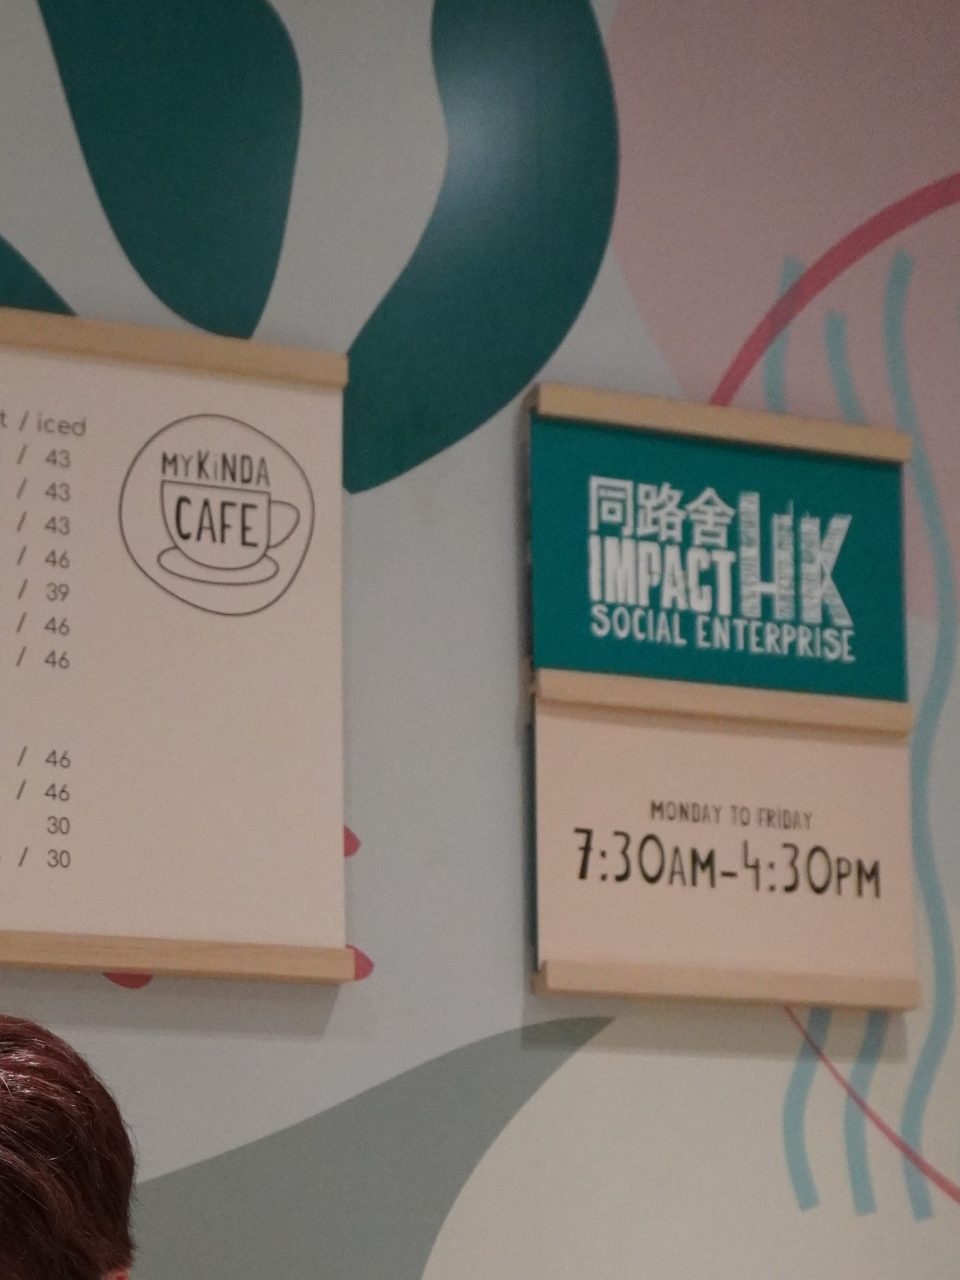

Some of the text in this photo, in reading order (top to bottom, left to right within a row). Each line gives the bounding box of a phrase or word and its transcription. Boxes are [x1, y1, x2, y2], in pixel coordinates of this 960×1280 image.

[37, 413, 86, 437] iced
[45, 449, 71, 468] 43
[45, 482, 70, 502] 43
[44, 516, 70, 535] 43
[176, 495, 259, 547] CAFE
[45, 550, 70, 569] 46
[588, 491, 853, 626] IMPACT HK
[46, 582, 70, 602] 39
[44, 617, 70, 636] 46
[591, 604, 856, 662] SOCIAL ENTERPRISE
[44, 650, 69, 669] 46
[45, 750, 70, 768] 46
[44, 783, 70, 802] 46
[650, 801, 812, 830] MONDAY TO FRIDAY
[47, 816, 70, 835] 30
[47, 849, 71, 868] 30
